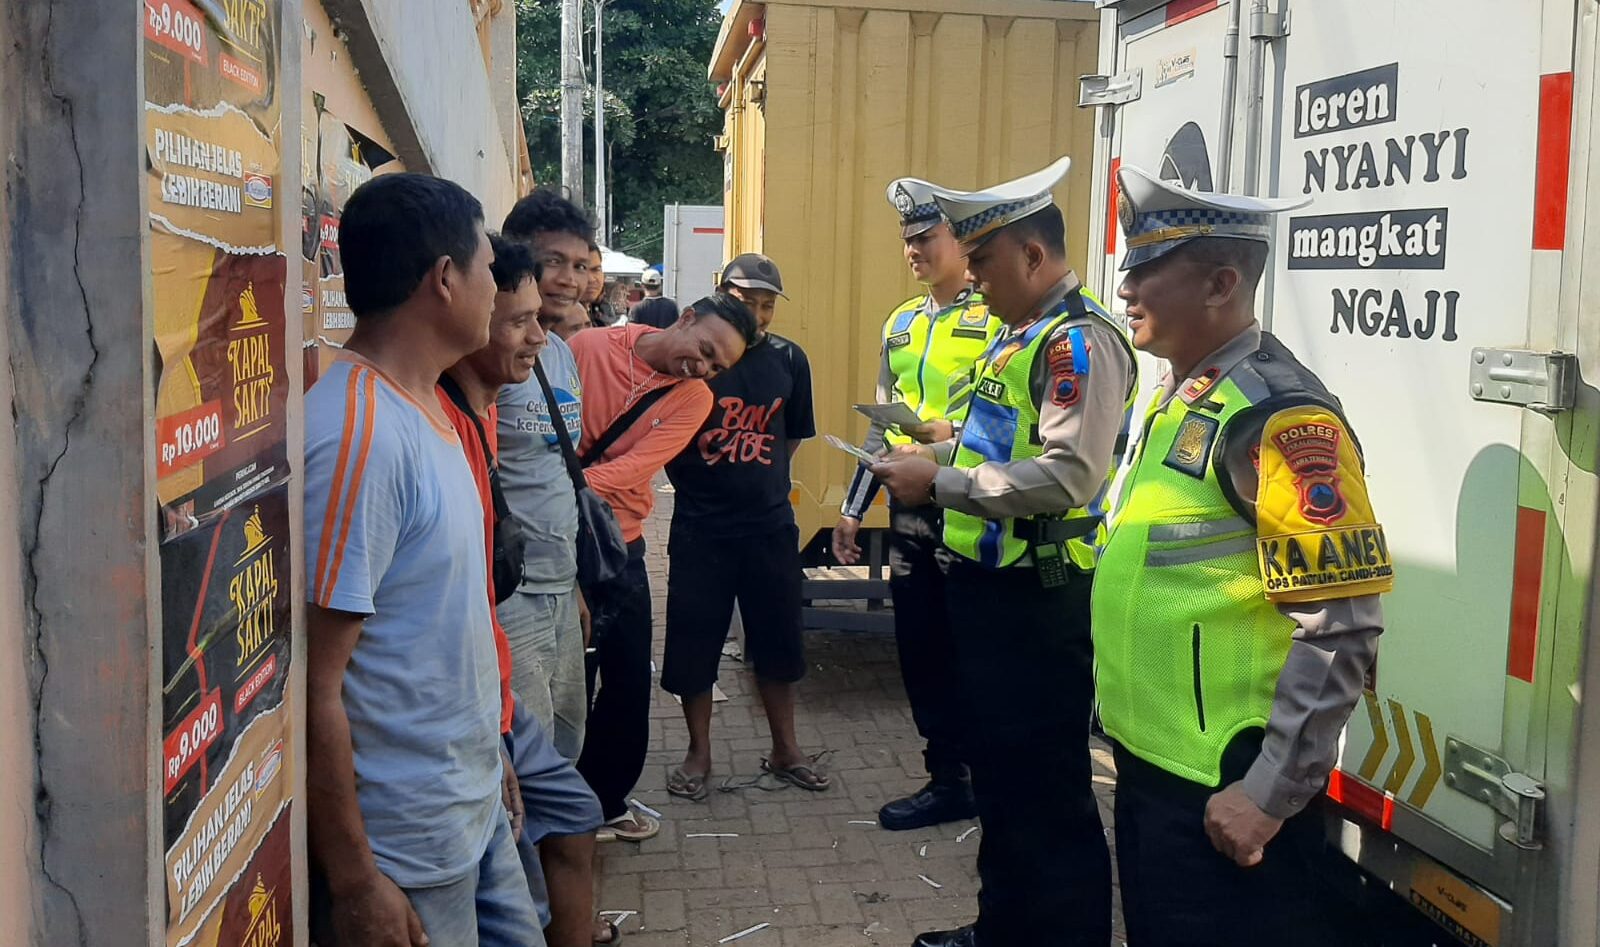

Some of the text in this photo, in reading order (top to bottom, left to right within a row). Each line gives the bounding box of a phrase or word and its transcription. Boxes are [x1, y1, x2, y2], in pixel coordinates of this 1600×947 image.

[149, 3, 201, 52] Rp9.000
[222, 59, 259, 88] BLACK EDITION
[1299, 82, 1390, 133] leren
[155, 127, 242, 178] PILIHAN JELAS
[1303, 128, 1470, 195] NYANYI
[162, 171, 200, 207] LEBIH
[200, 179, 241, 213] BERANI
[1293, 213, 1443, 268] mangkat
[1330, 288, 1460, 341] NGAJI
[227, 333, 273, 386] KAPAL
[233, 377, 273, 429] SAKTI
[698, 427, 775, 465] CABE
[1279, 425, 1334, 444] POLRES
[1261, 527, 1388, 577] KA ANEV
[230, 548, 277, 622] KAPAL
[1267, 577, 1290, 590] OPS
[236, 598, 274, 667] SAKTI
[239, 659, 273, 705] BLACK EDITION
[168, 702, 217, 778] Rp9.000
[173, 801, 224, 893] PILIHAN
[223, 761, 254, 821] JELAS
[179, 799, 253, 926] LEBIH BERANI
